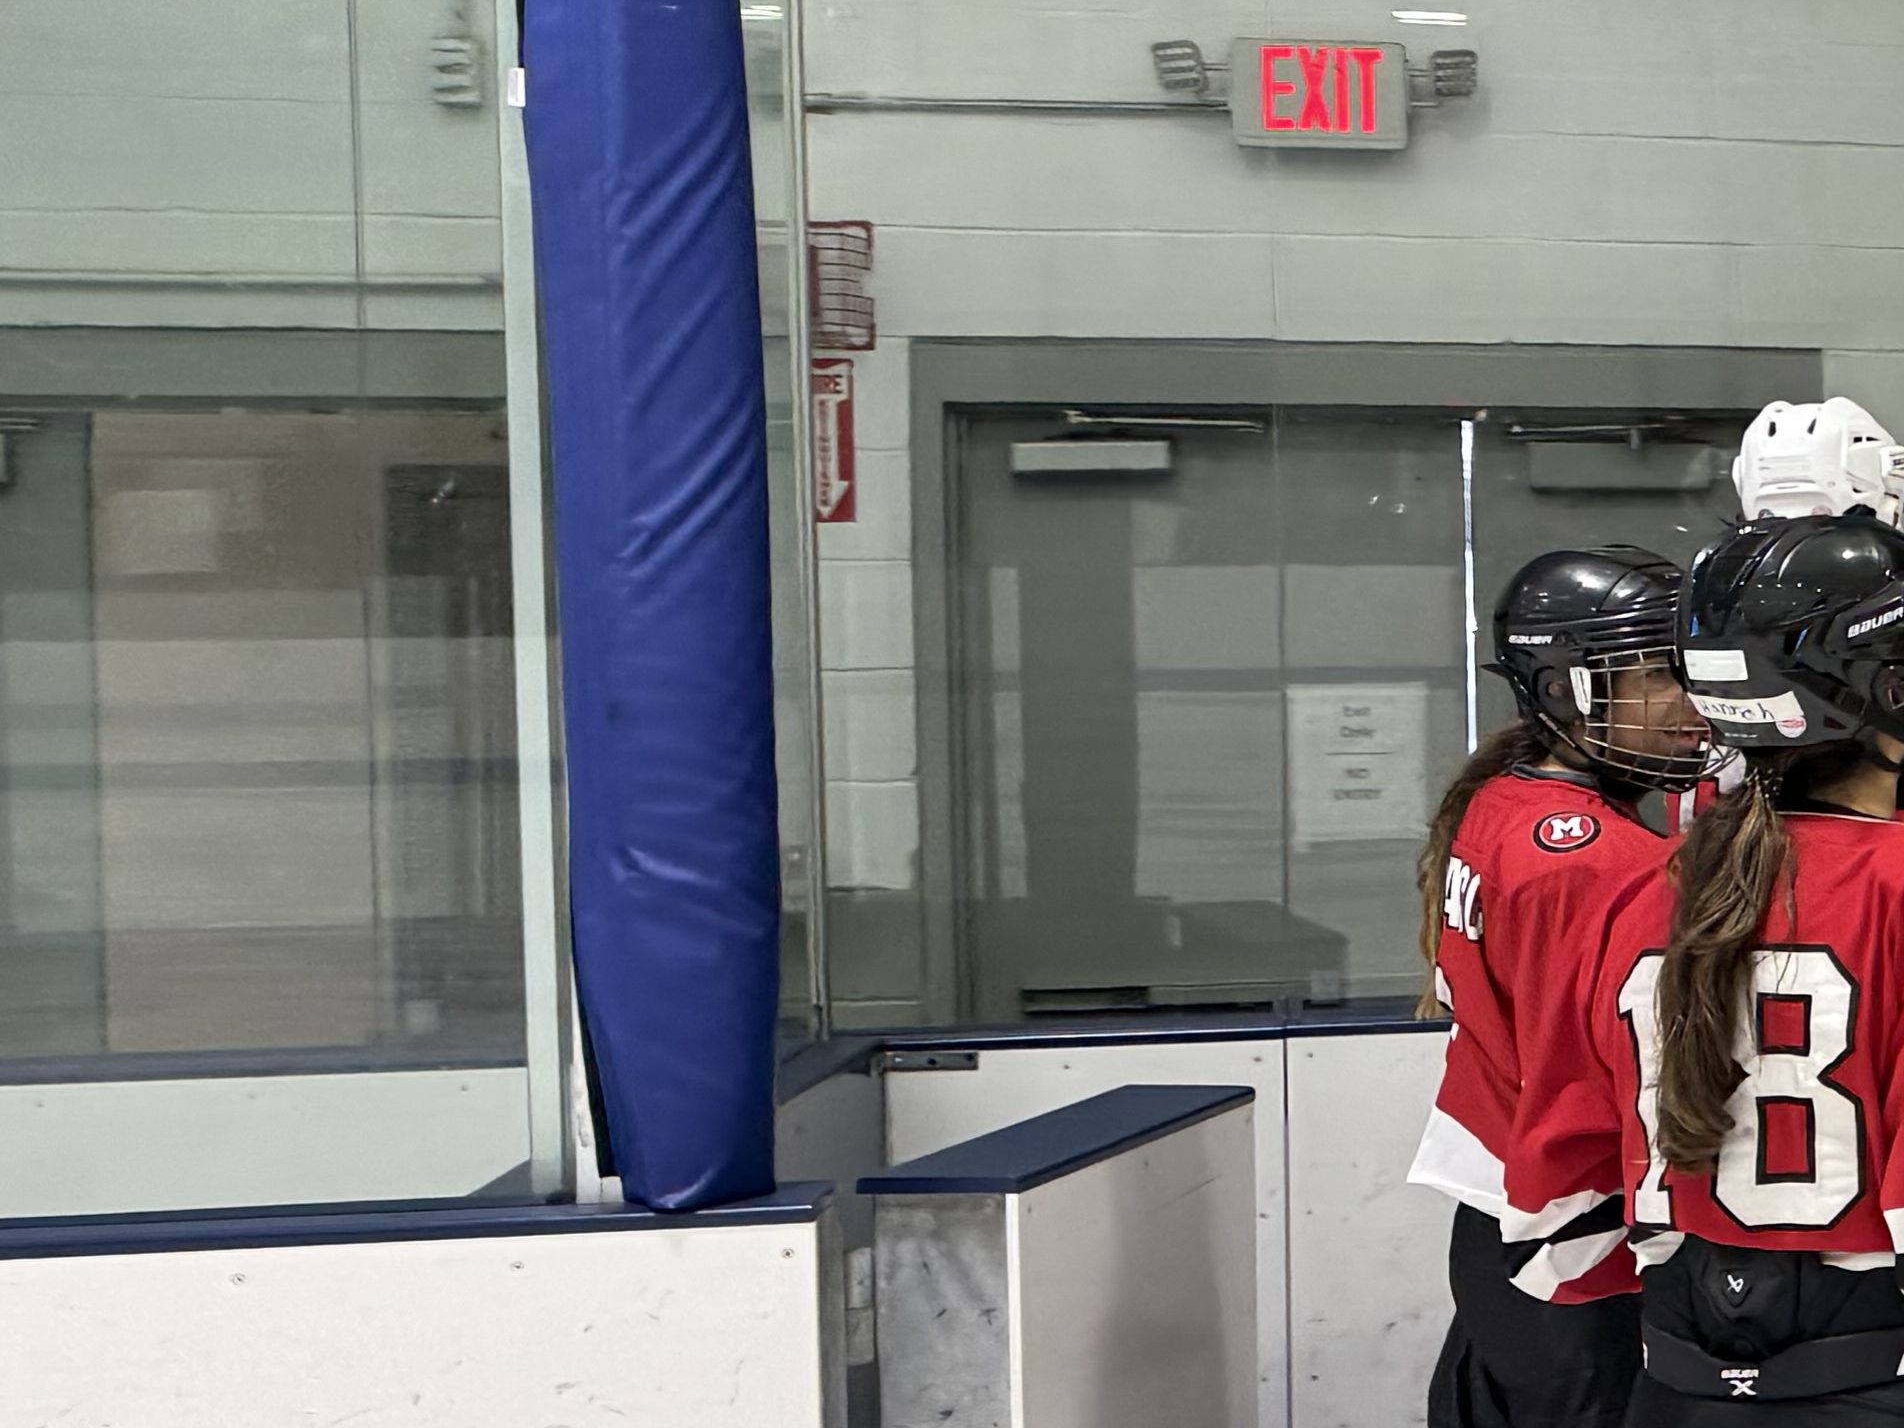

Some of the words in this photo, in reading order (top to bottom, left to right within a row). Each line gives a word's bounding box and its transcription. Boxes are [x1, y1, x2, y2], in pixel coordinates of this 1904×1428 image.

[1260, 44, 1383, 134] EXIT
[1847, 606, 1904, 638] BAUER
[1550, 815, 1585, 841] M
[1617, 943, 1867, 1231] 18
